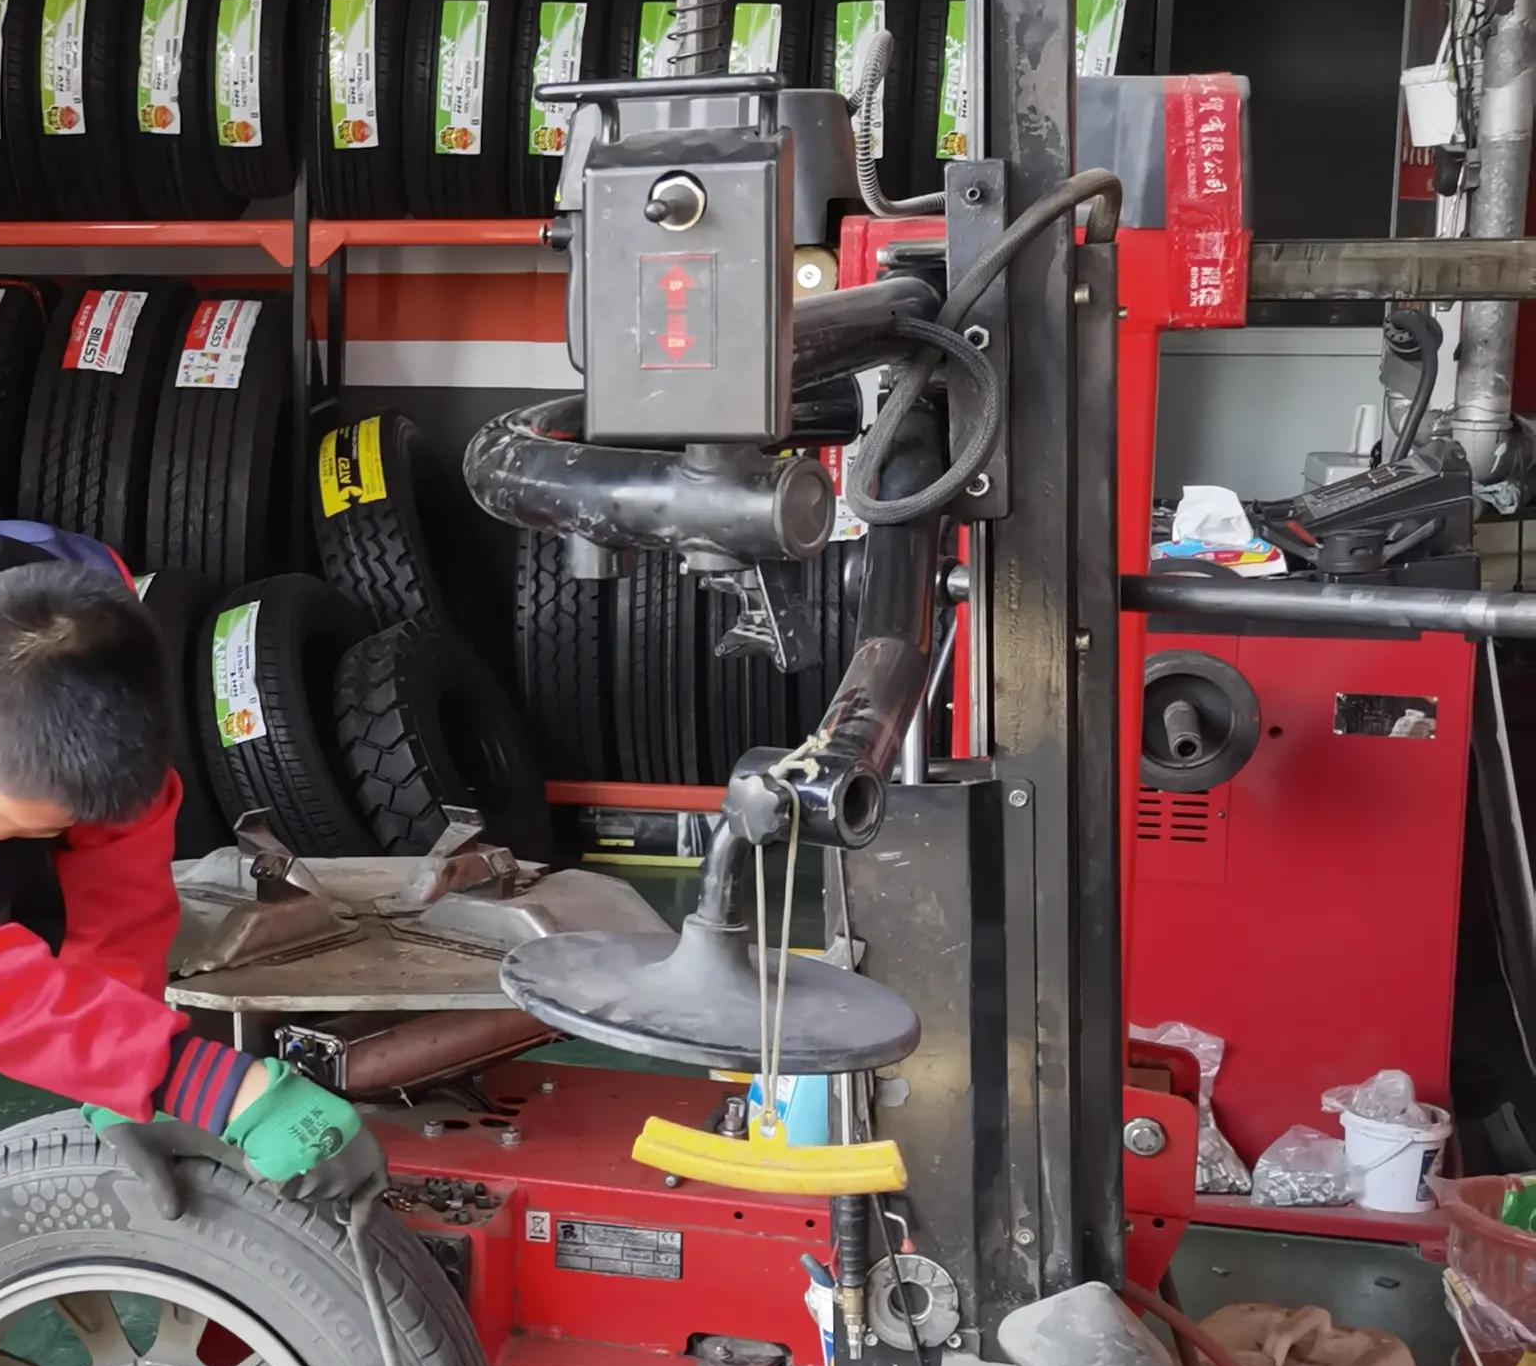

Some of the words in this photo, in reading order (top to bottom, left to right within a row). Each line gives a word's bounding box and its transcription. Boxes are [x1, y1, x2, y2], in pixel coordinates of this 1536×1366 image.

[41, 21, 56, 91] PRINX
[438, 35, 456, 112] PRINX
[838, 37, 855, 97] RINX
[944, 34, 964, 116] PRINX
[670, 280, 684, 291] UP
[82, 325, 104, 364] CST118
[337, 456, 352, 484] AT27
[214, 636, 230, 699] PRINX
